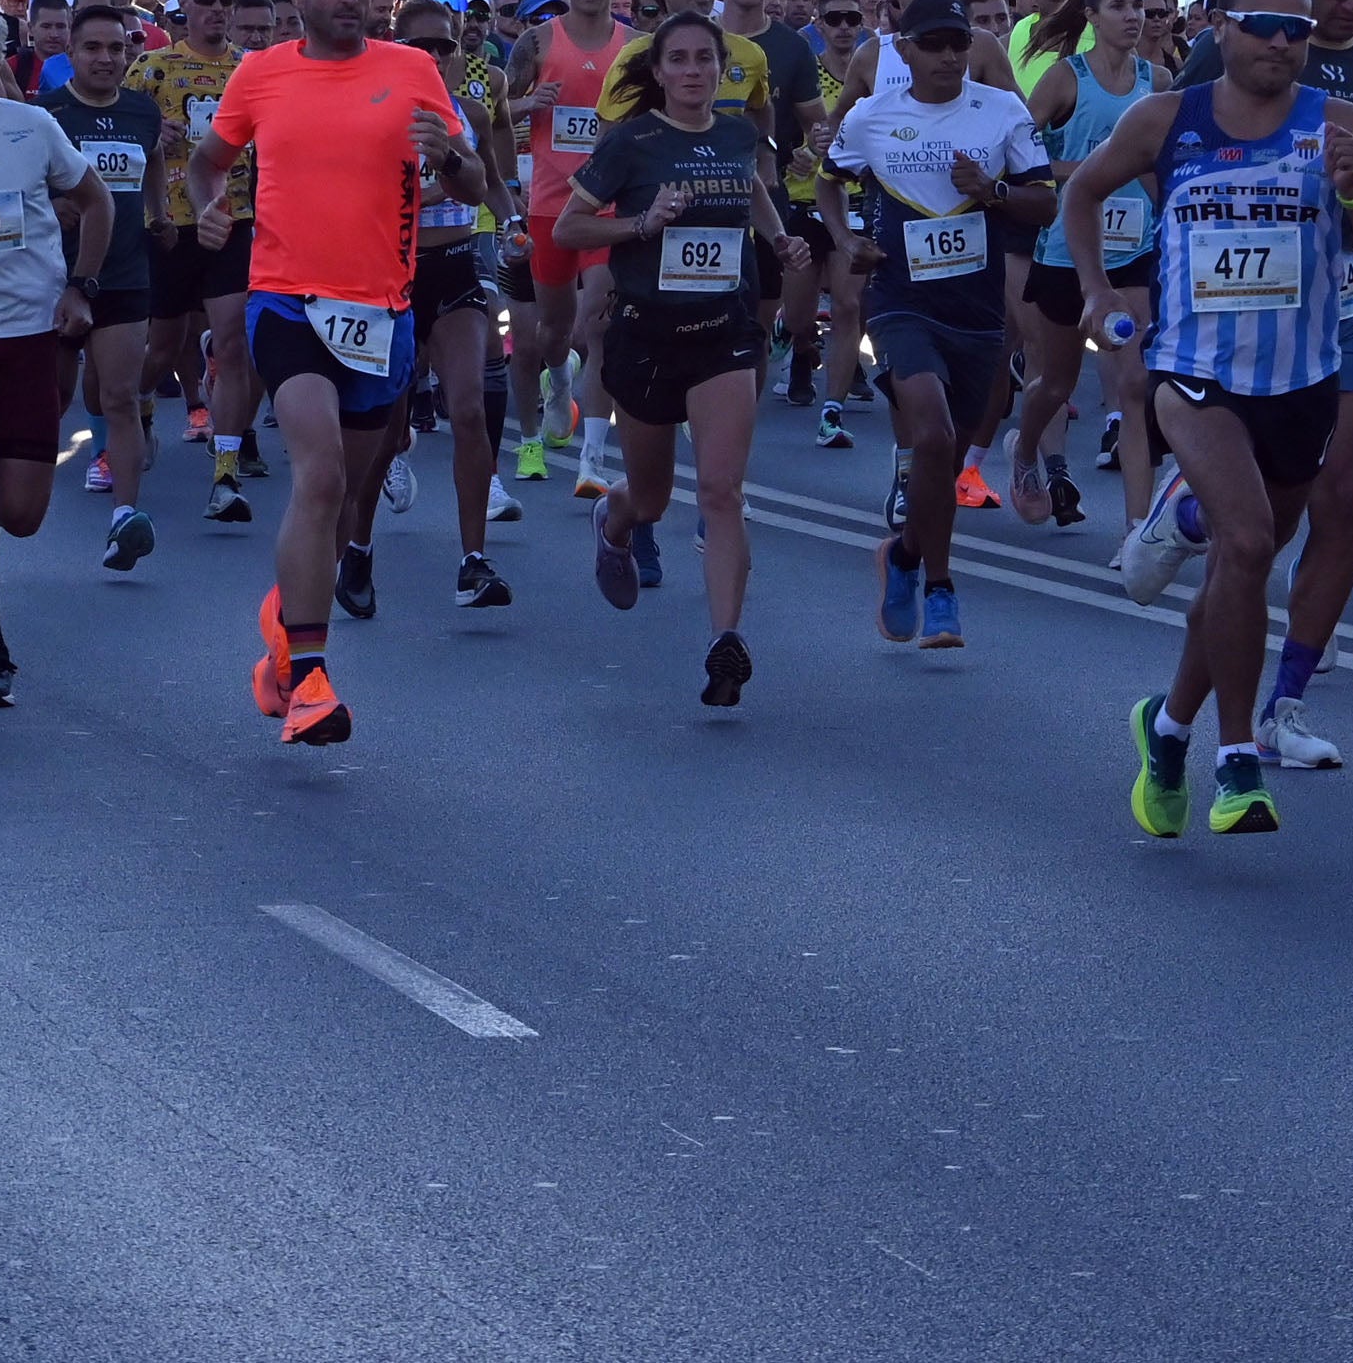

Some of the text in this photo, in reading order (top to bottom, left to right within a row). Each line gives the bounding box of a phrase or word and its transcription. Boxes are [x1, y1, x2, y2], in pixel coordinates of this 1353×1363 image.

[566, 116, 598, 136] 578
[921, 140, 953, 149] HOTEL
[97, 152, 128, 172] 603
[885, 151, 901, 160] LOS
[887, 163, 934, 174] TRIATLON
[1172, 162, 1202, 178] vive
[1188, 185, 1300, 198] ATLETISMO
[1172, 197, 1321, 224] MÁLAGA
[924, 228, 966, 256] 165
[681, 241, 722, 268] 692
[1214, 247, 1271, 280] 477
[324, 314, 369, 347] 178
